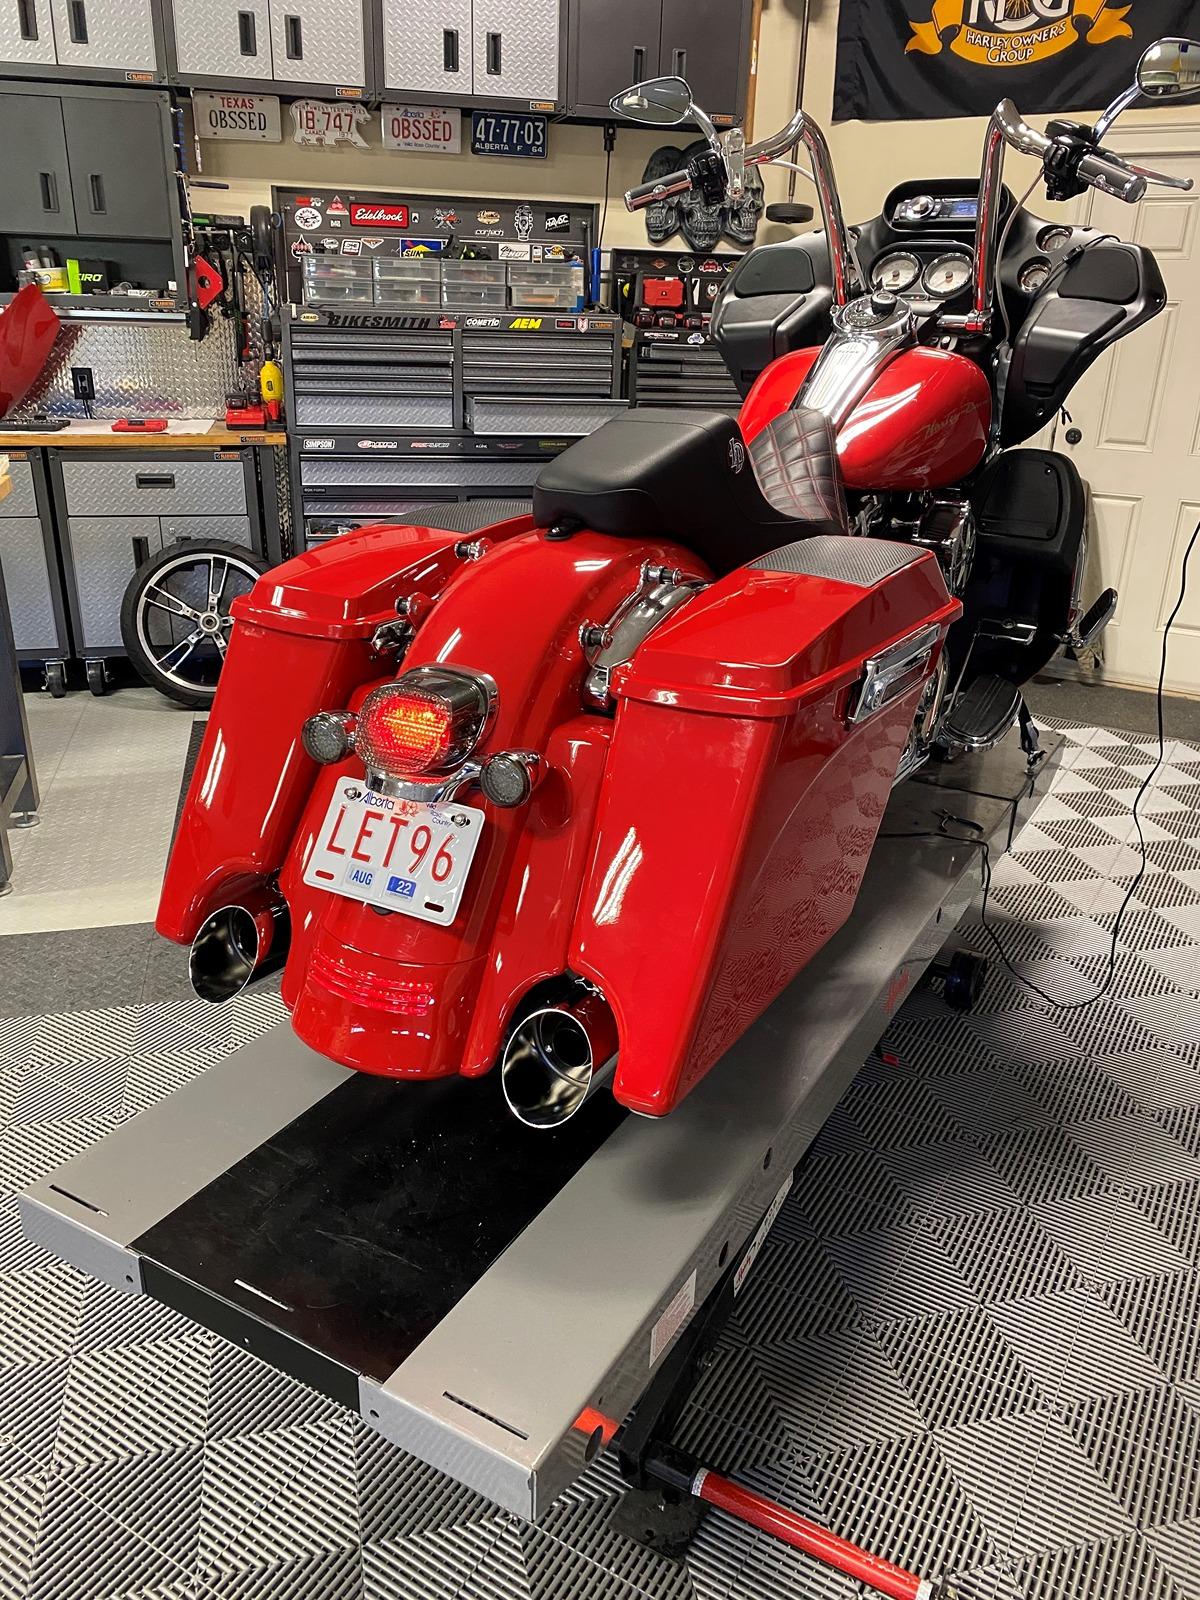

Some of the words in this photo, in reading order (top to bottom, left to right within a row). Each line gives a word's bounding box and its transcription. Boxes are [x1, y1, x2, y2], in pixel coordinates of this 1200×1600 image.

[966, 29, 1011, 49] HARLEY
[1011, 21, 1067, 49] OWNERS
[986, 45, 1034, 63] GROUP
[219, 96, 254, 109] TEXAS
[209, 109, 267, 132] OBSSED
[304, 129, 327, 137] CANADA
[391, 117, 452, 142] OBSSED
[474, 142, 510, 151] ALBERTA
[354, 208, 403, 222] Edelbrock
[326, 314, 431, 329] BIKESMITH
[466, 316, 500, 327] COMETIC
[509, 317, 543, 329] AEM
[305, 440, 333, 448] SIMPSON
[359, 790, 396, 811] Alberta
[326, 804, 456, 883] LET96
[351, 869, 373, 886] AUG
[395, 880, 412, 895] 22
